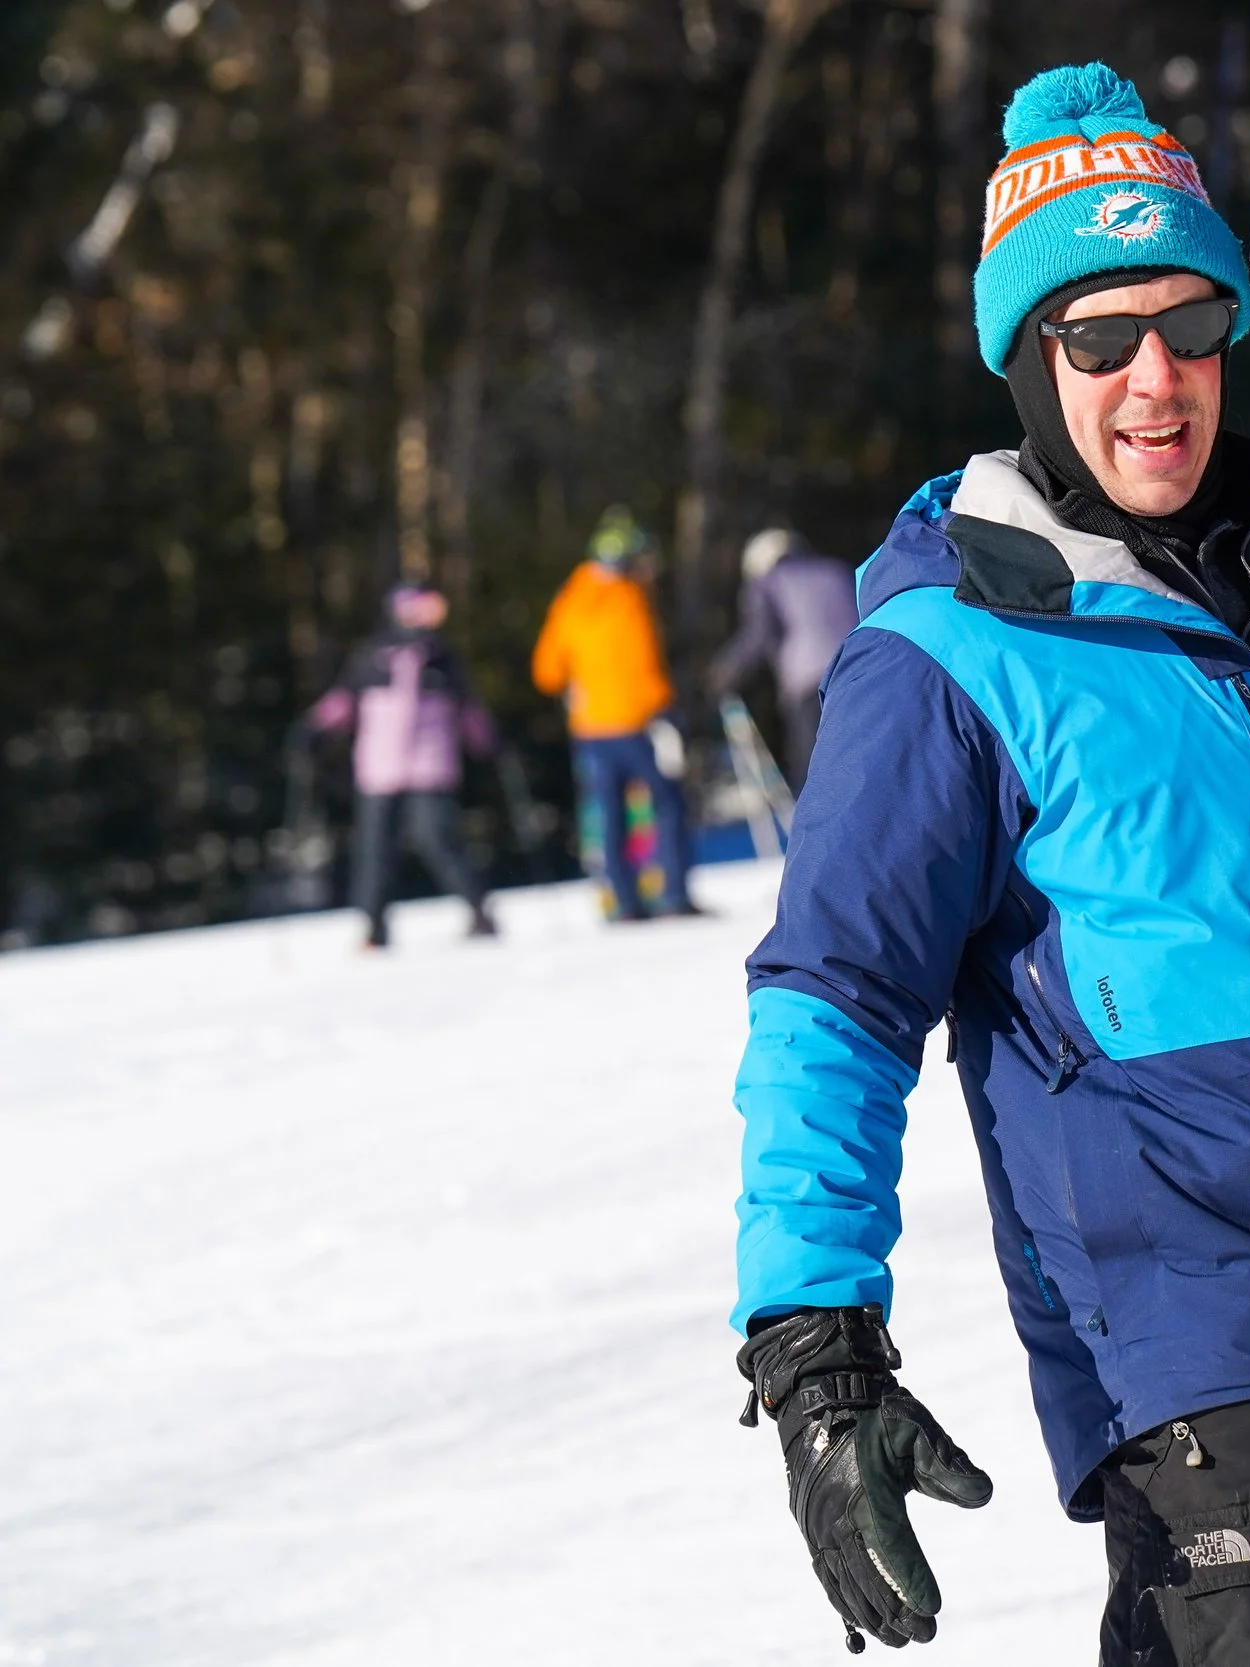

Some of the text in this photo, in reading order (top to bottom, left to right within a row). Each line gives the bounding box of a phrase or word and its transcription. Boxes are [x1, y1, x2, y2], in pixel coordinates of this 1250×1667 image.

[1096, 975, 1122, 1033] lofoten
[1194, 1530, 1223, 1544] THE
[1173, 1541, 1225, 1561] NORTH
[1189, 1552, 1227, 1568] FACE
